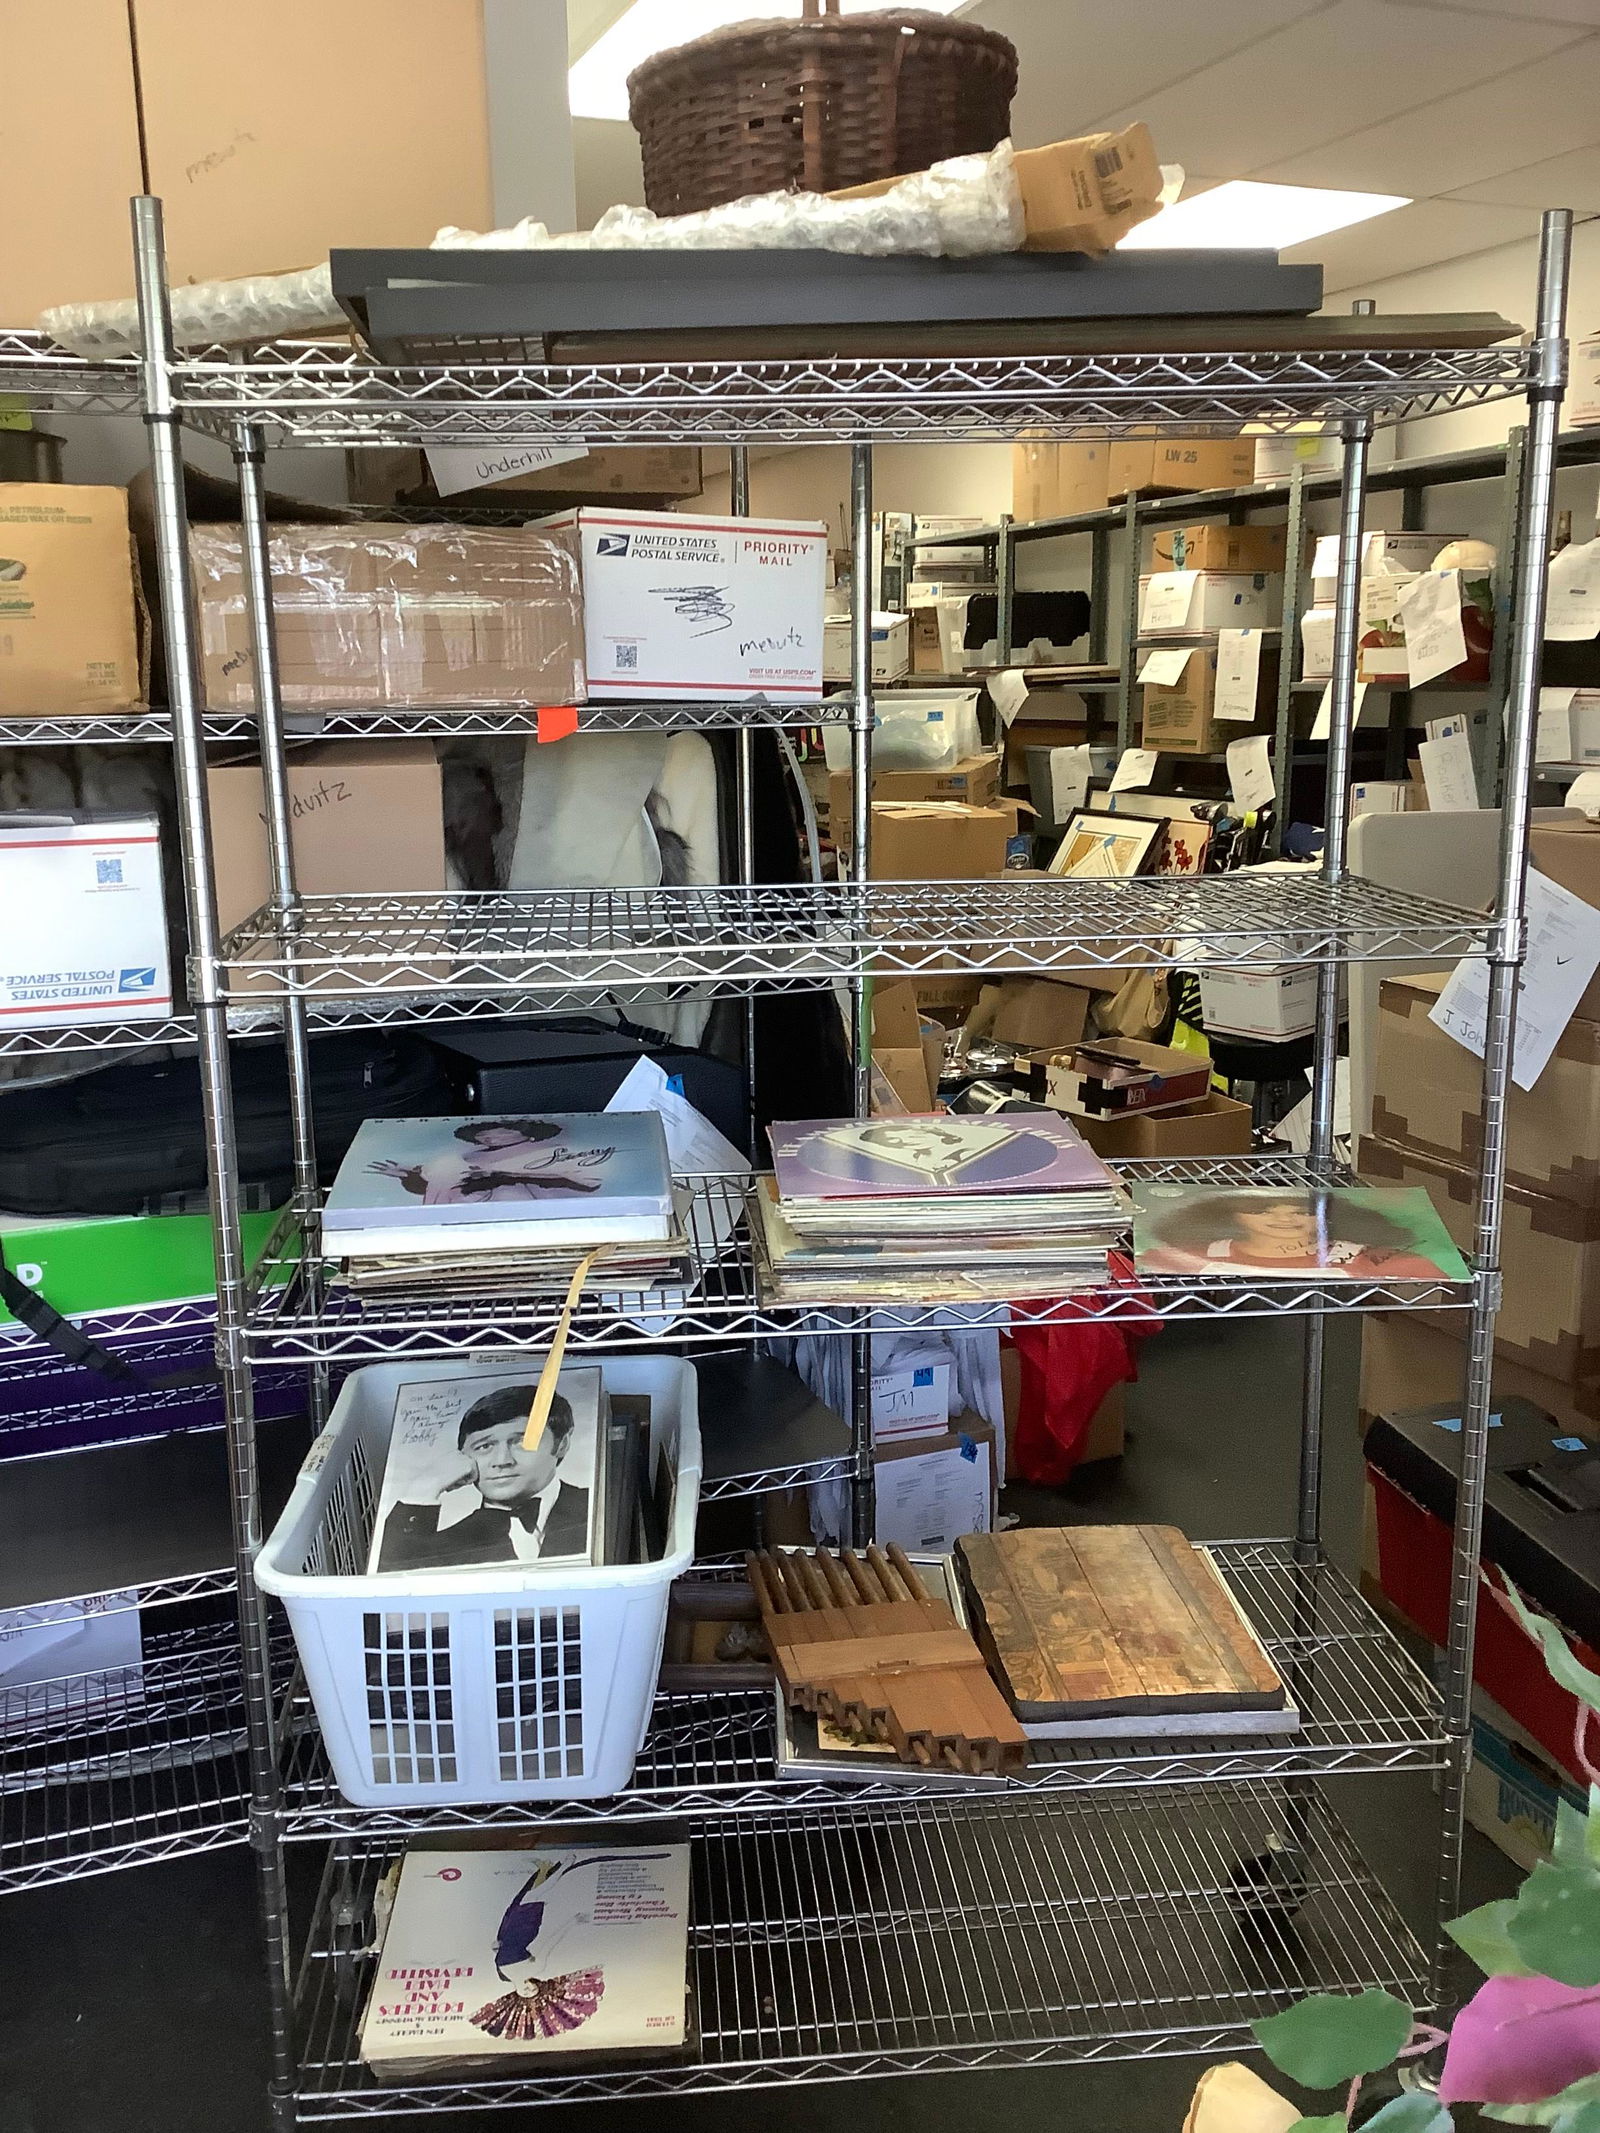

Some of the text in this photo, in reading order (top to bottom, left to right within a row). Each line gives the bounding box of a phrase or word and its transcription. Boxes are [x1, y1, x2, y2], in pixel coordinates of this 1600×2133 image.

[476, 447, 553, 479] Underhill
[1184, 450, 1198, 464] 25
[634, 534, 717, 549] UNITED STATES
[744, 540, 809, 555] PRIORITY
[631, 549, 719, 563] POSTAL SERVICE
[759, 556, 793, 567] MAIL
[6, 969, 115, 986] POSTAL SERVICE
[11, 984, 113, 1001] UNITED STATES
